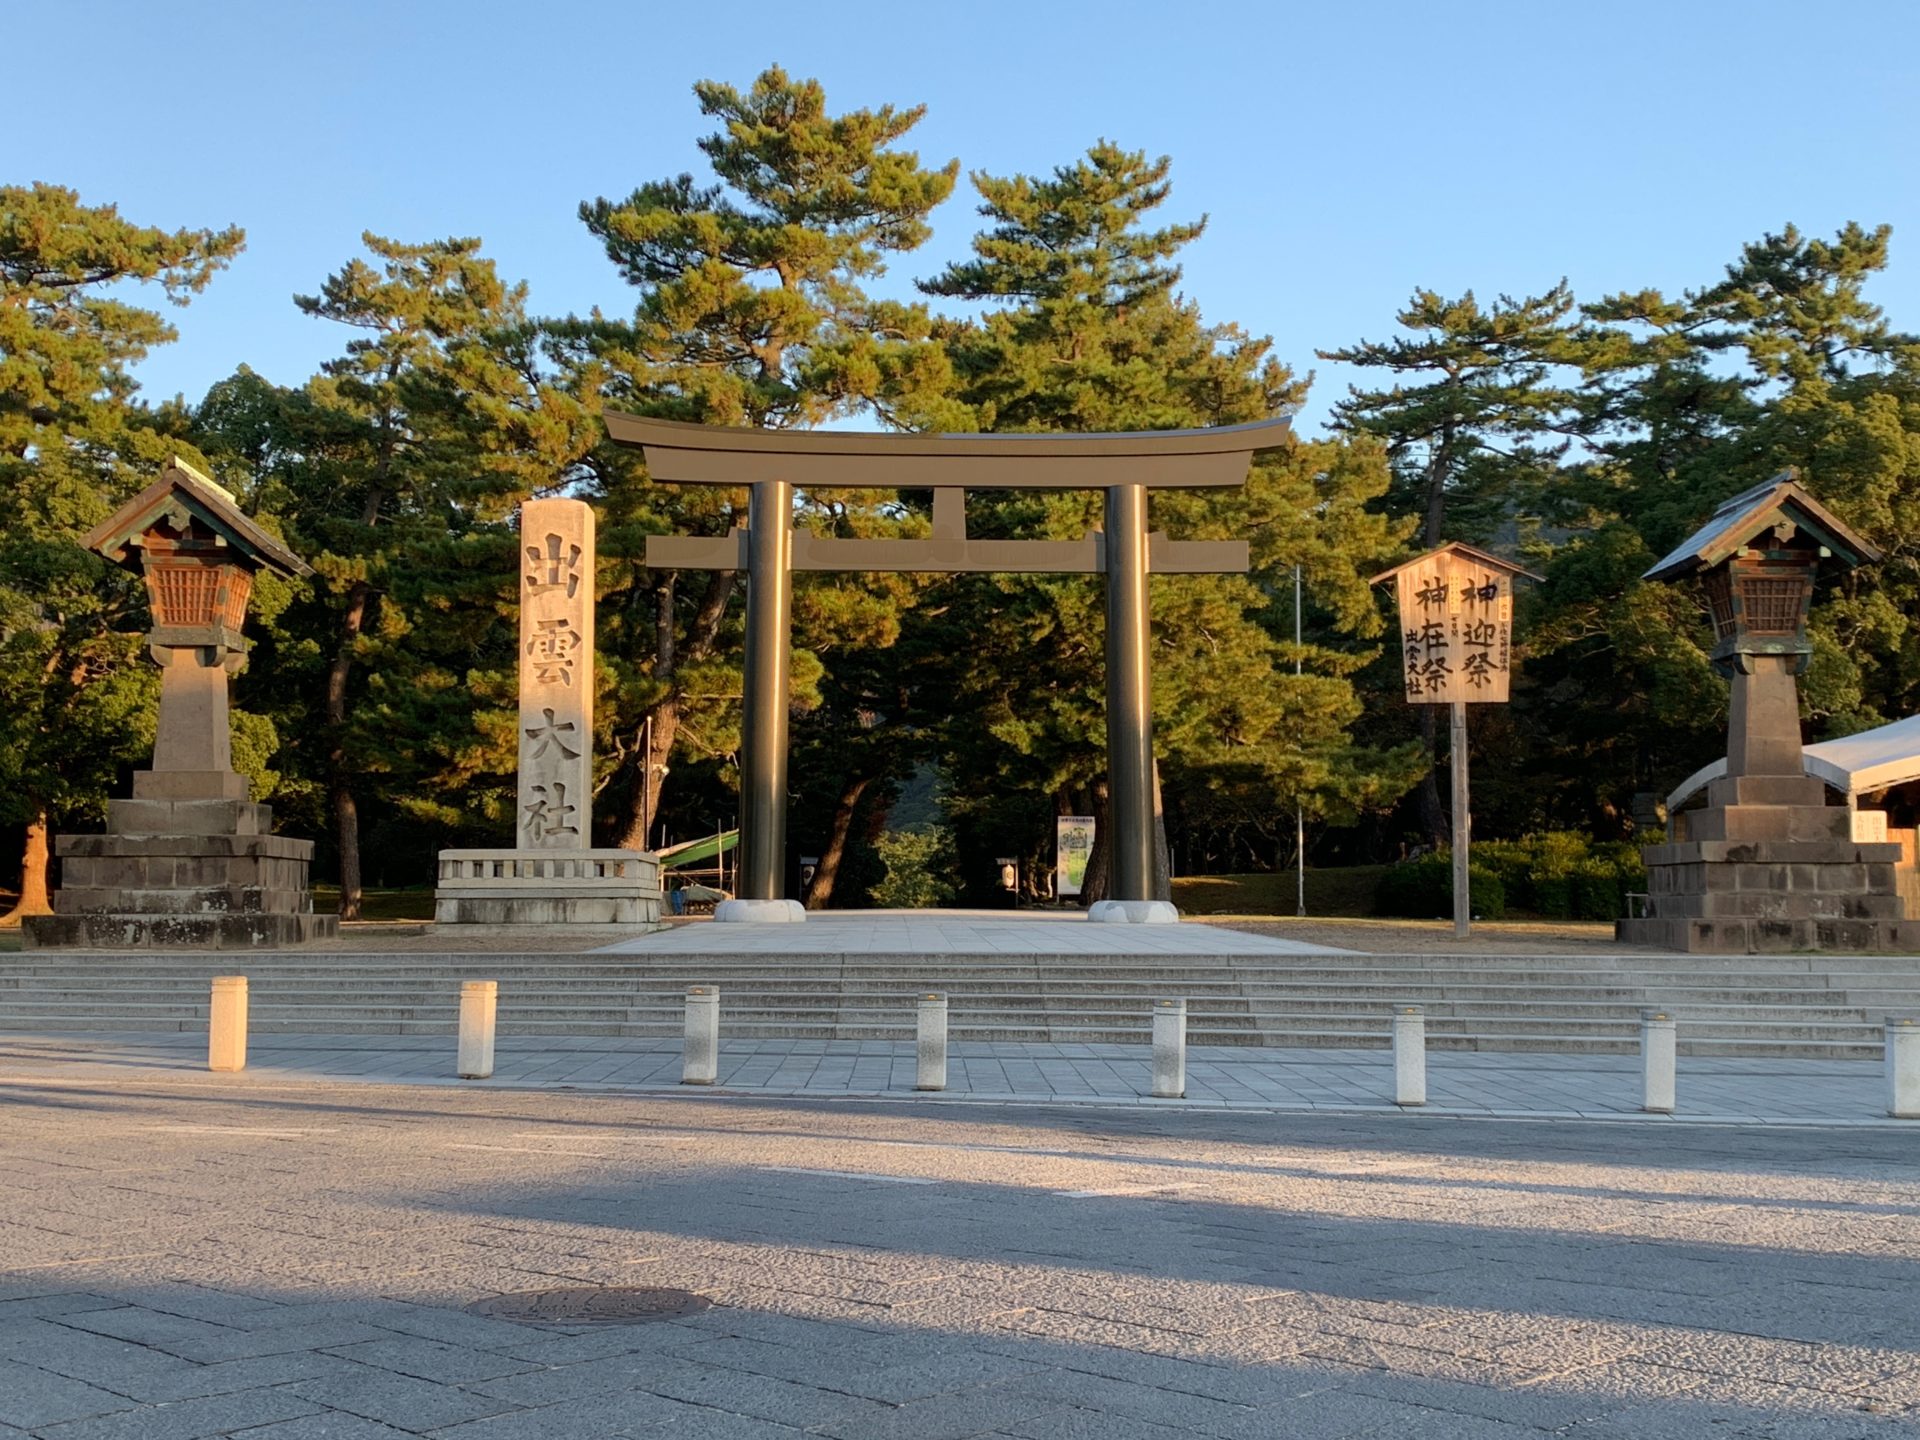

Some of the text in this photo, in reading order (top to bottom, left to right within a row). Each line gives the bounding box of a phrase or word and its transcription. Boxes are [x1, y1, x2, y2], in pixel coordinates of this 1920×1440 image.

[522, 532, 583, 842] 出雲大社
[1405, 628, 1424, 696] 出雲大社
[1414, 576, 1453, 693] 神在祭
[1460, 574, 1499, 689] 神迎祭
